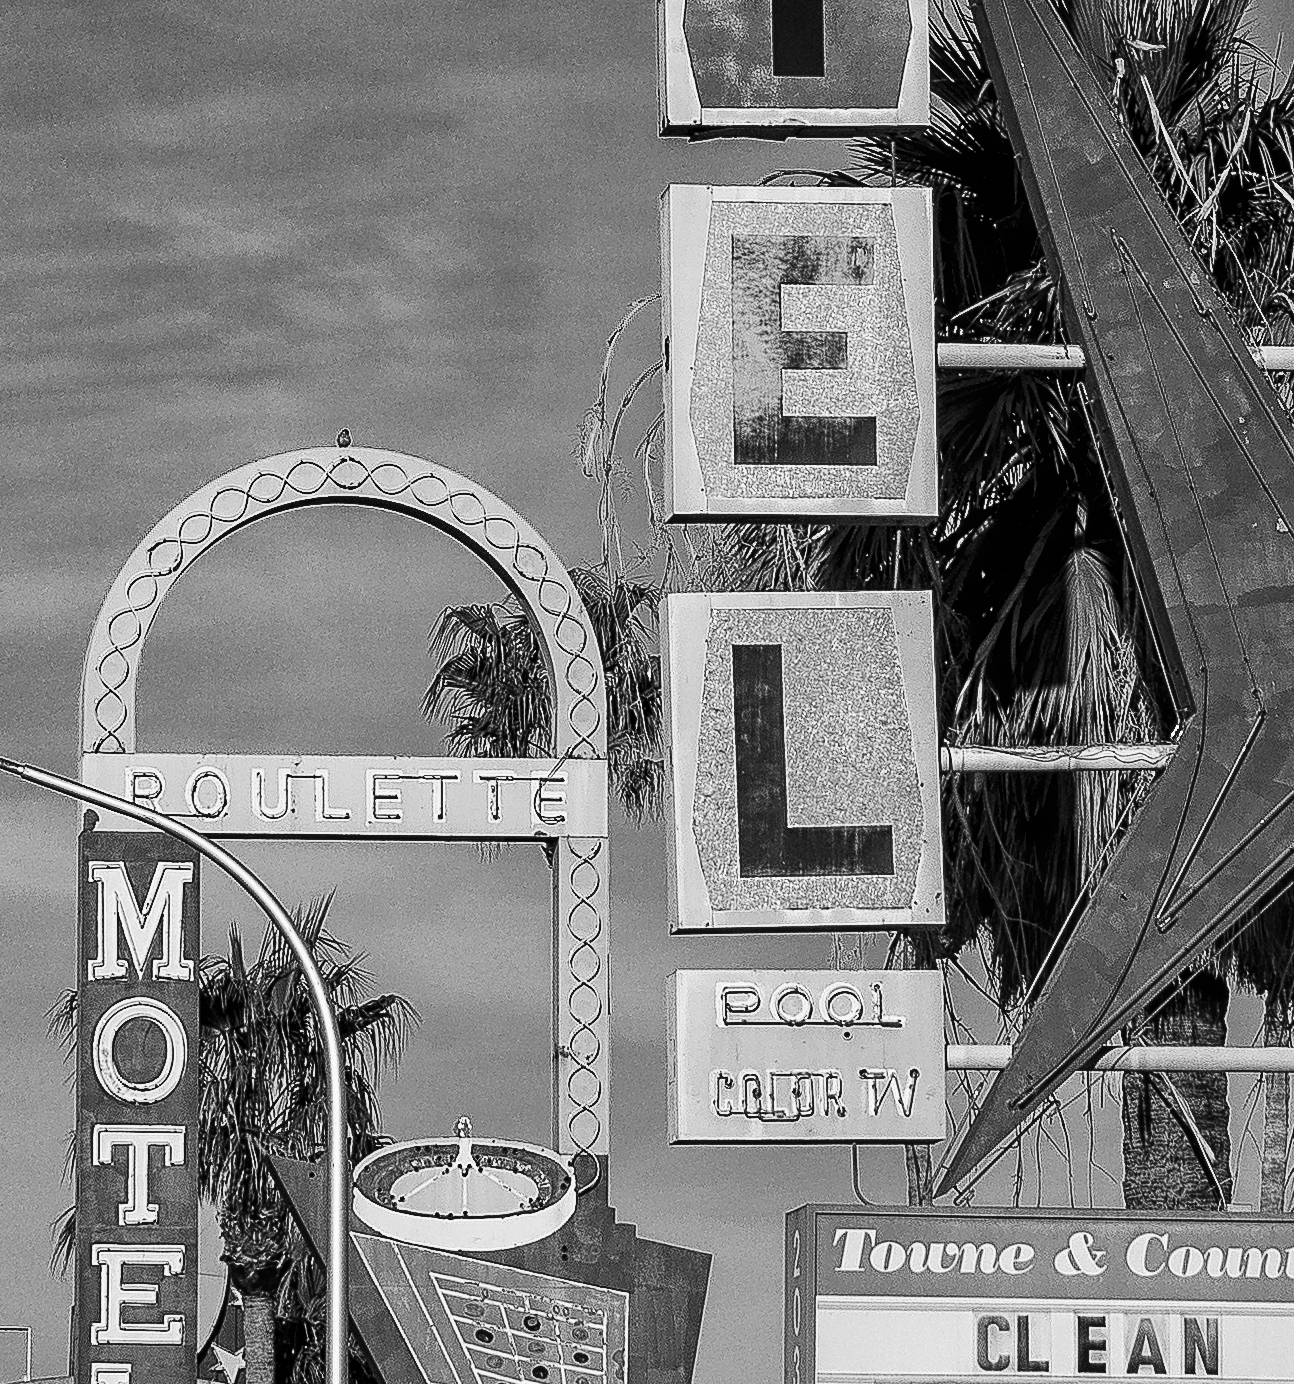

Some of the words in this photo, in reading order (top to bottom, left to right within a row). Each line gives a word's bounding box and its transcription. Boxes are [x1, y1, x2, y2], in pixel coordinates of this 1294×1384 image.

[125, 766, 571, 824] ROULETTE
[717, 980, 905, 1028] POOL
[713, 1069, 847, 1122] COLOR
[860, 1067, 921, 1119] TV
[831, 1227, 1036, 1274] Towne
[1052, 1230, 1108, 1277] &
[975, 1313, 1220, 1377] CLEAN
